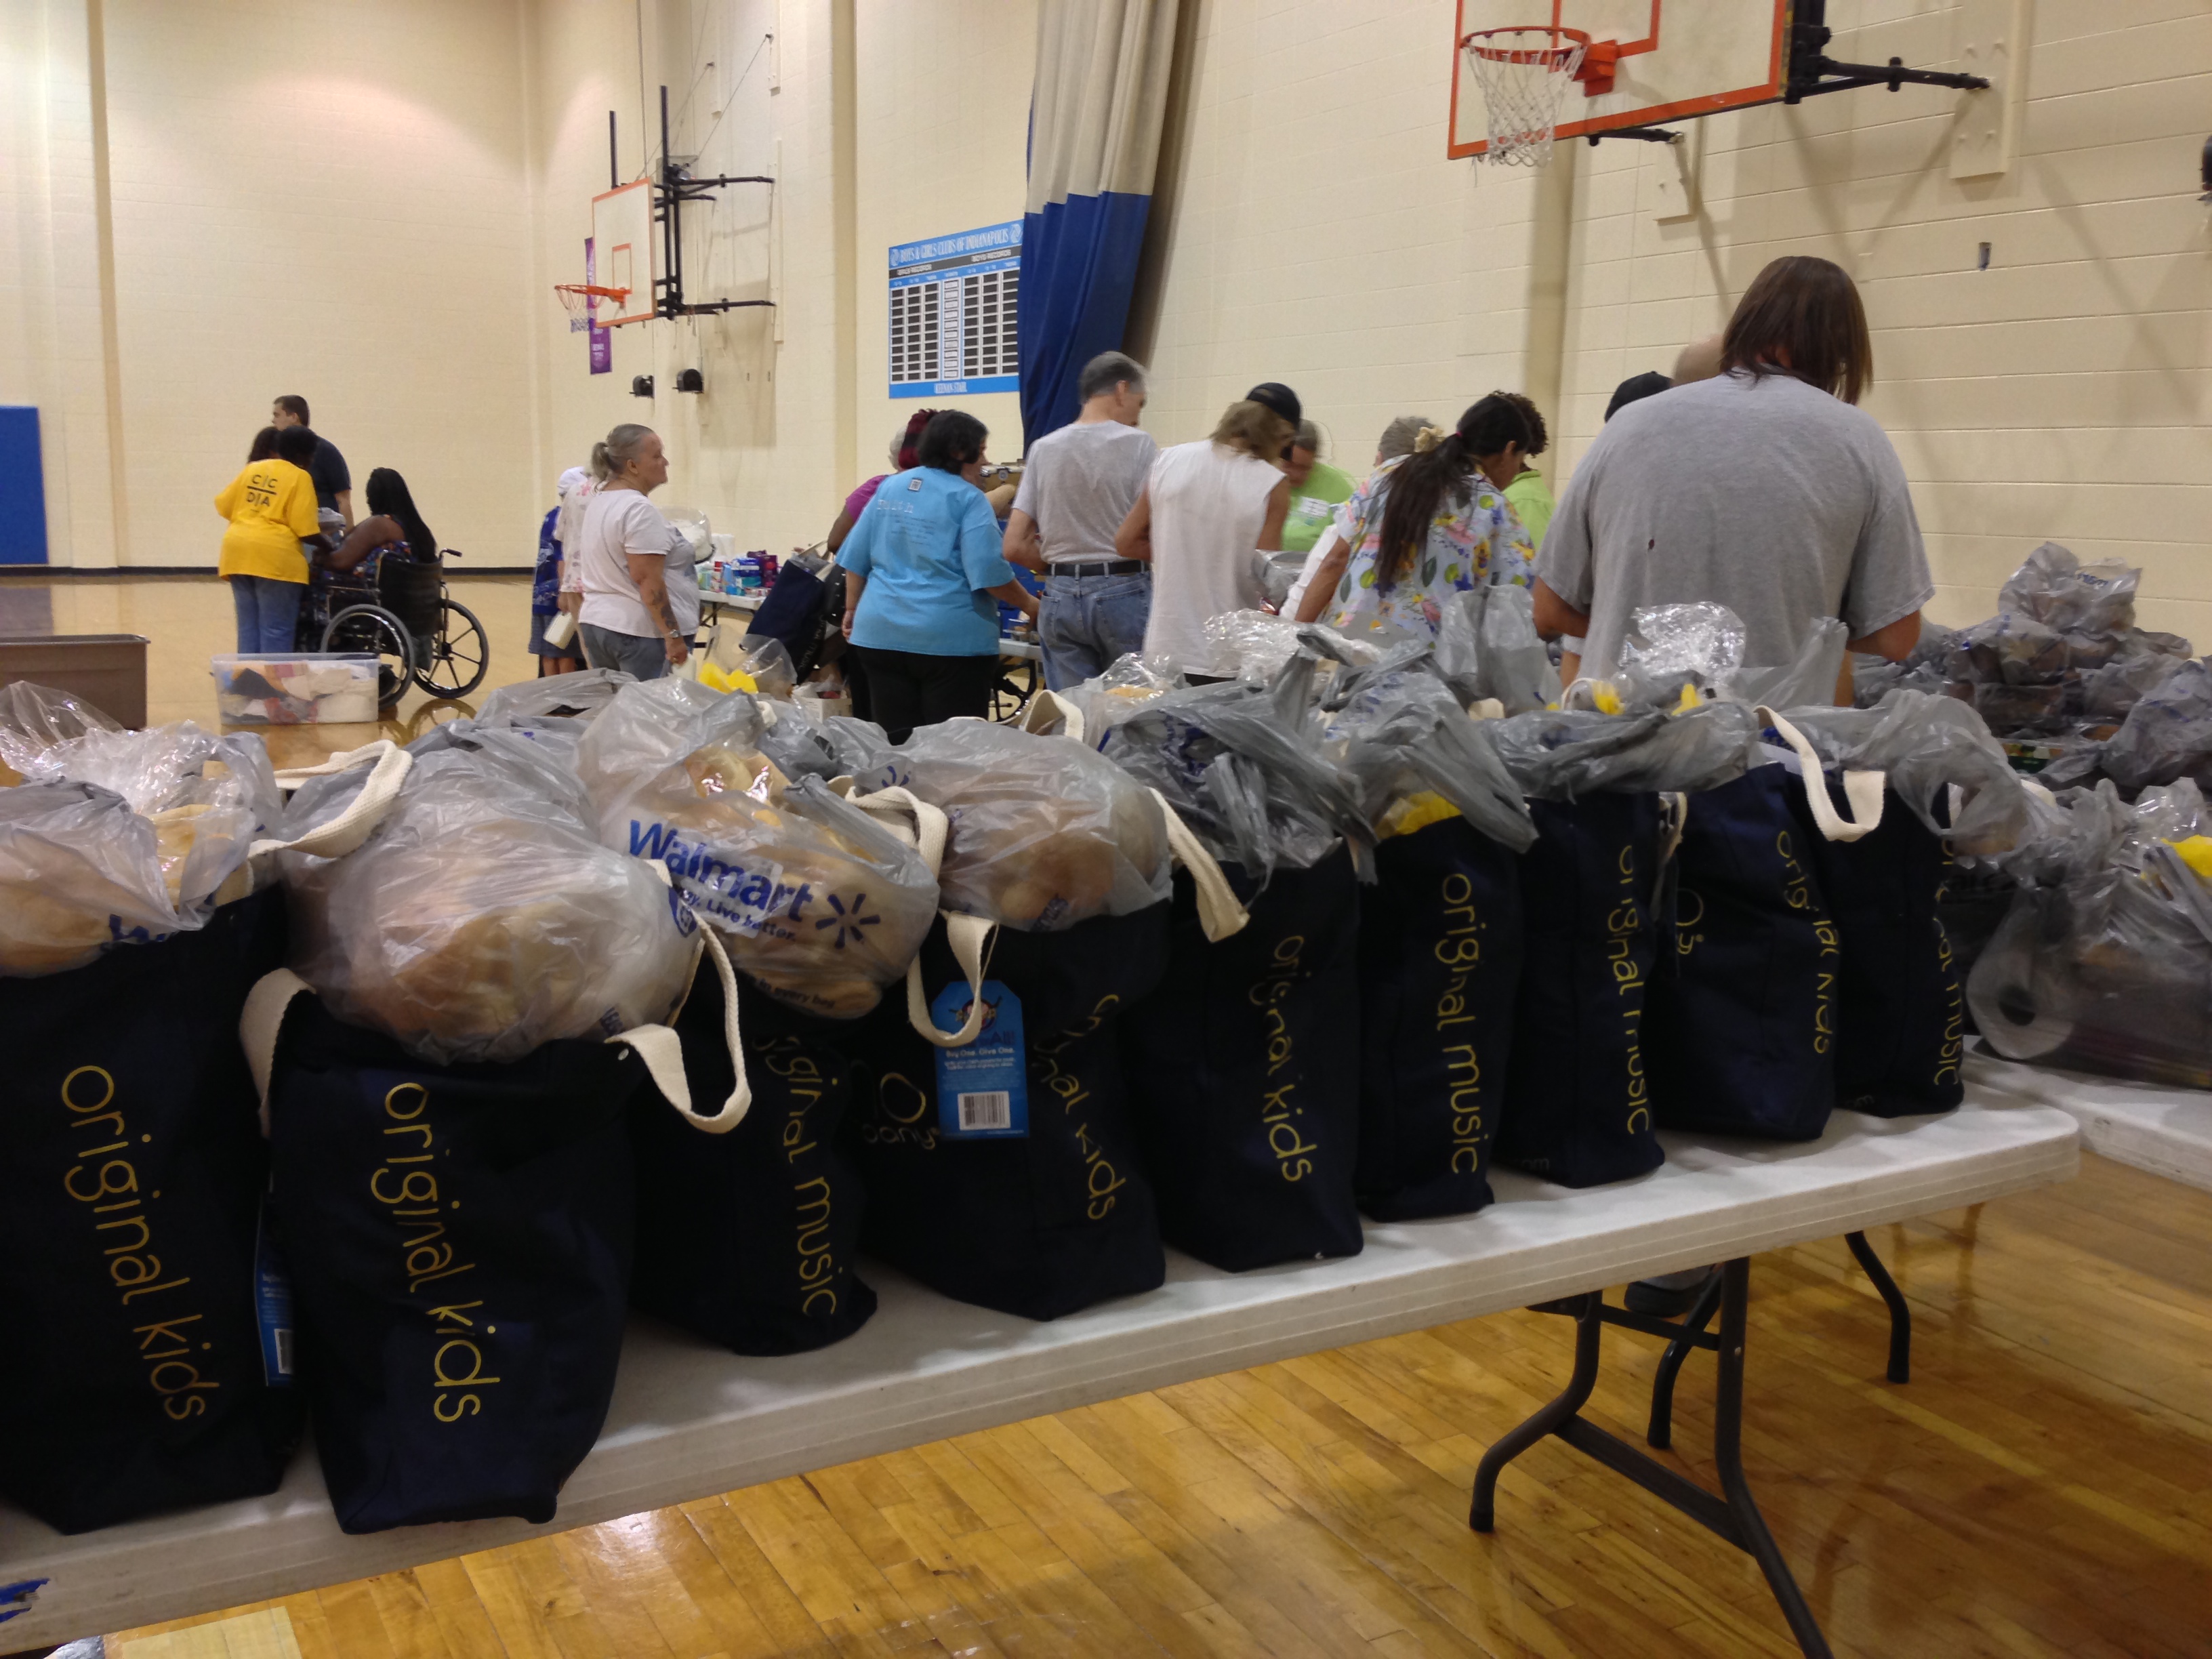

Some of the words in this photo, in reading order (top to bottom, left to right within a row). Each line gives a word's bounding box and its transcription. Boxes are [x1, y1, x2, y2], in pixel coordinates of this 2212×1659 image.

[900, 247, 915, 262] BOYS
[920, 242, 937, 259] GIRLS
[938, 239, 956, 255] CLUBS
[956, 237, 965, 251] OF
[966, 228, 1009, 250] INDIANAPOLIS
[629, 819, 813, 923] Walmart
[706, 899, 741, 924] Live
[1262, 1083, 1317, 1182] kids
[1441, 1044, 1489, 1174] music
[1075, 1122, 1126, 1221] kids
[62, 1065, 191, 1306] original
[132, 1313, 220, 1420] kids
[370, 1082, 476, 1294] original
[424, 1300, 501, 1422] kids
[794, 1176, 843, 1317] music
